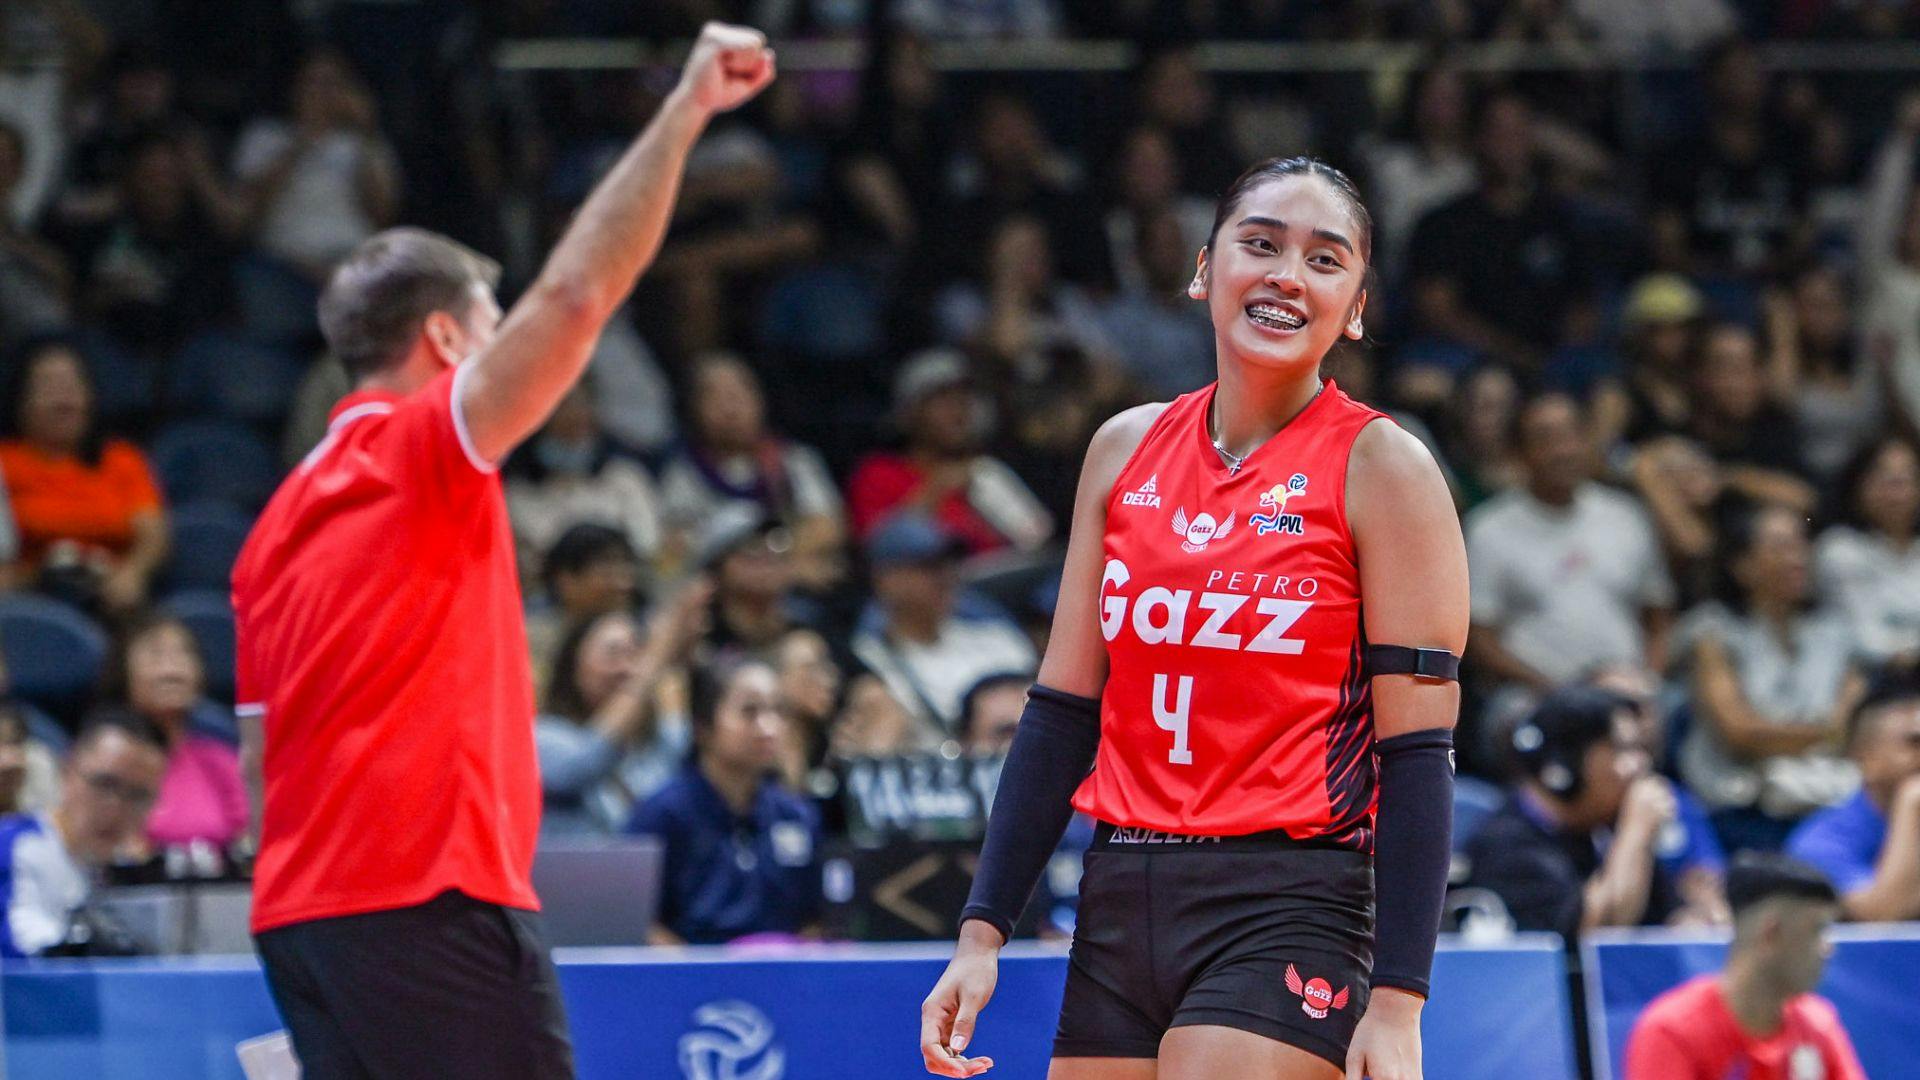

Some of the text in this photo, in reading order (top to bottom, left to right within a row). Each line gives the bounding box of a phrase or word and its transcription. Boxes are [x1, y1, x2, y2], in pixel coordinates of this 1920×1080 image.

[1122, 491, 1161, 509] DELTA
[1278, 514, 1303, 533] PVL
[1207, 569, 1318, 597] PETRO
[1099, 558, 1315, 655] Gazz
[1152, 673, 1194, 765] 4
